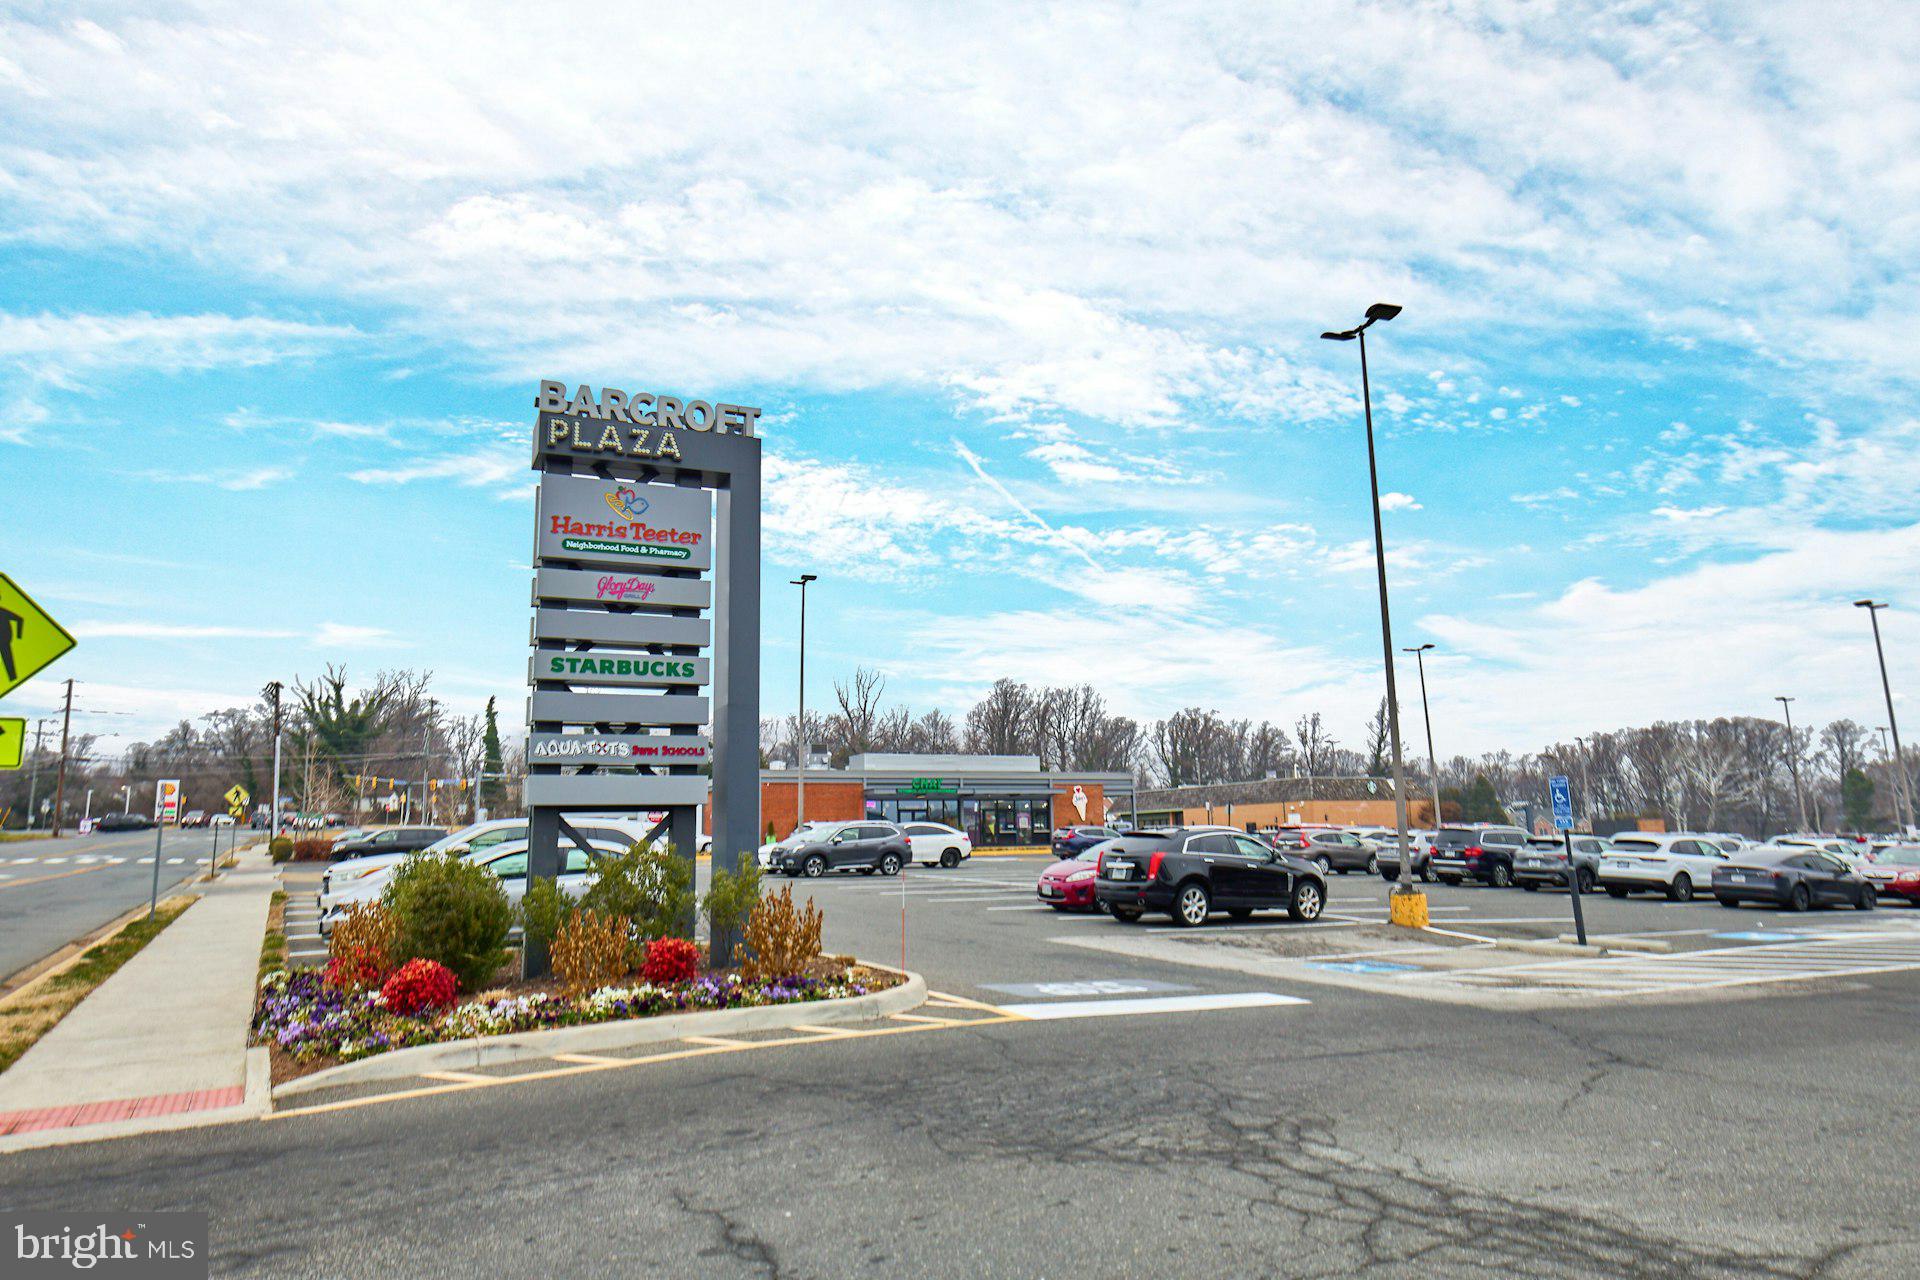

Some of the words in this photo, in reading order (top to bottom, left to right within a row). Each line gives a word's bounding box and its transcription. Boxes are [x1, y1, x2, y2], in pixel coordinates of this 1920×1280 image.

[539, 379, 761, 437] BARCROFT
[548, 418, 682, 460] PLAZA
[551, 515, 627, 538] Harris
[630, 522, 702, 545] Teeter
[566, 540, 620, 552] Neighborhood
[621, 545, 640, 553] Food
[640, 546, 649, 554] &
[650, 547, 687, 558] Pharmacy
[597, 576, 627, 600] Glory
[627, 577, 655, 600] Days
[550, 657, 695, 678] STARBUCKS
